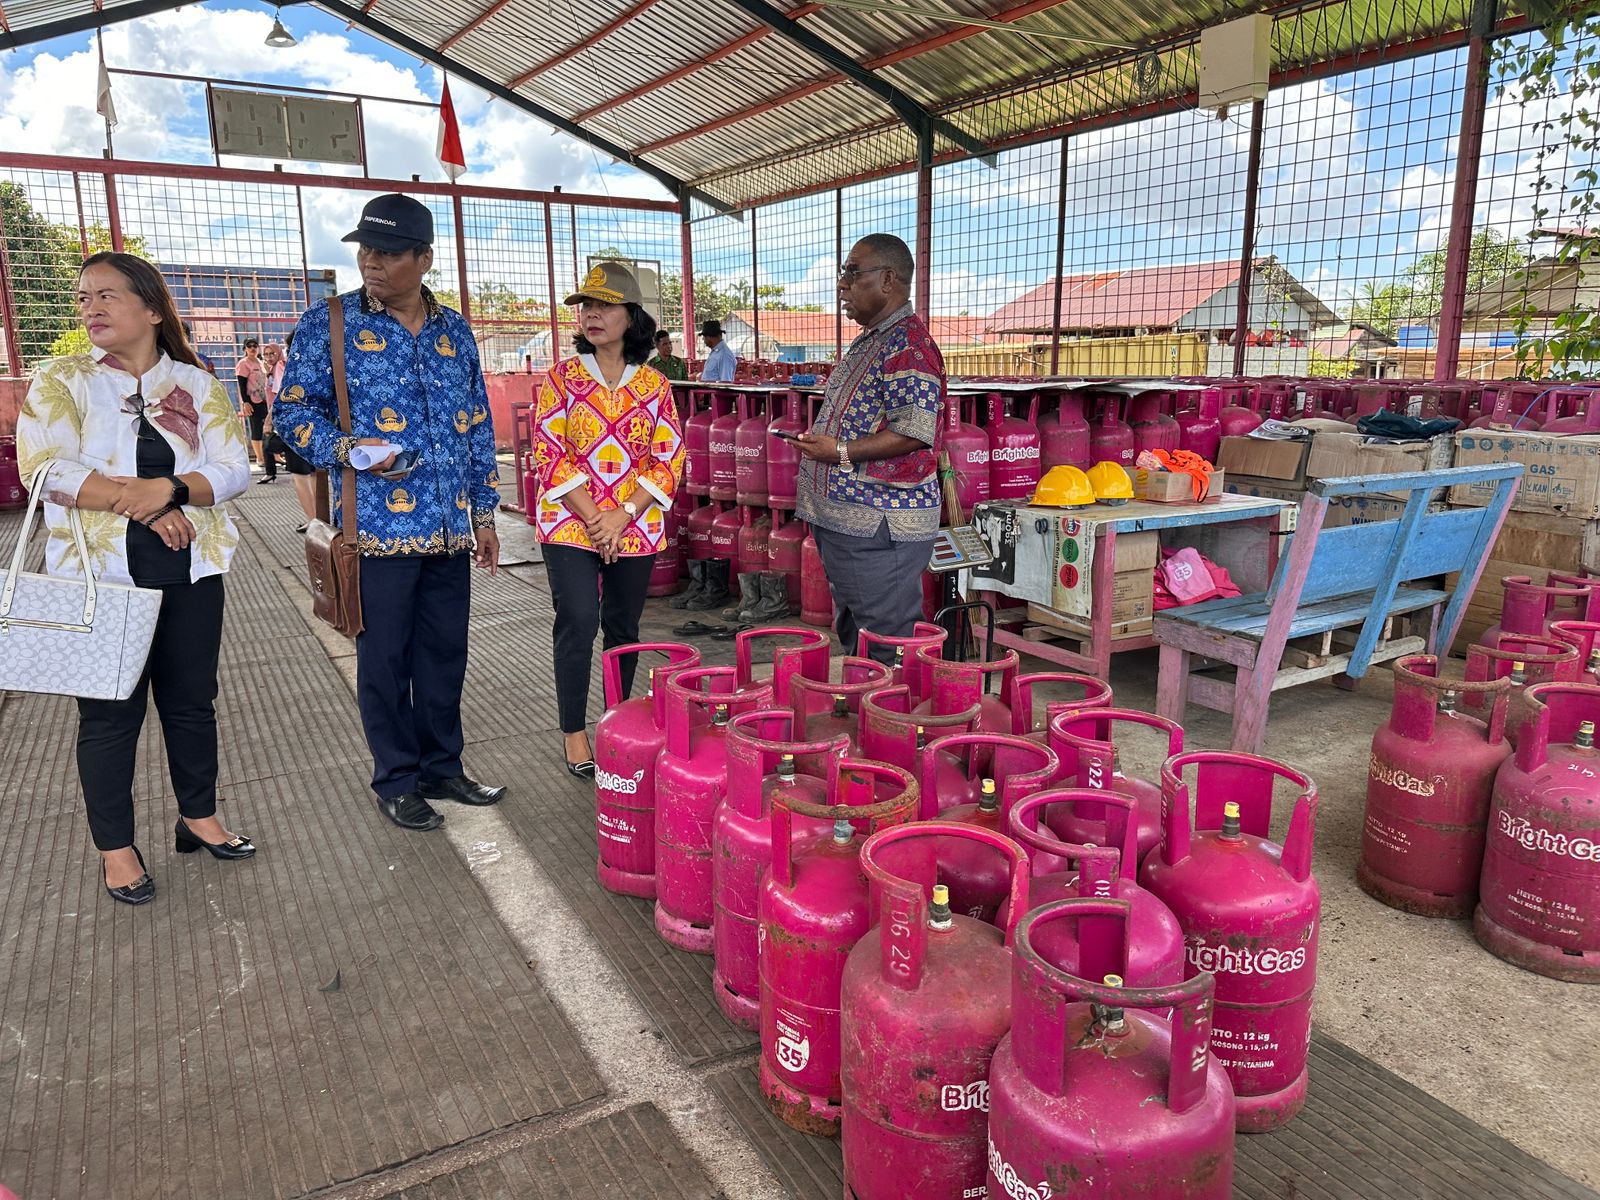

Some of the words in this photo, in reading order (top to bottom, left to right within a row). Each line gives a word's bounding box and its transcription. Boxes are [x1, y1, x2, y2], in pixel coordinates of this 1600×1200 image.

[967, 450, 989, 464] Brigh
[992, 447, 1026, 462] Bright
[1530, 464, 1555, 475] GAS
[612, 774, 637, 794] Gas
[1393, 770, 1435, 797] Gas
[1499, 810, 1568, 857] Bright
[1567, 838, 1600, 863] Ga
[1253, 947, 1306, 975] Gas
[1243, 1032, 1255, 1041] 12
[1257, 1031, 1270, 1041] kg
[941, 1080, 990, 1113] Brig
